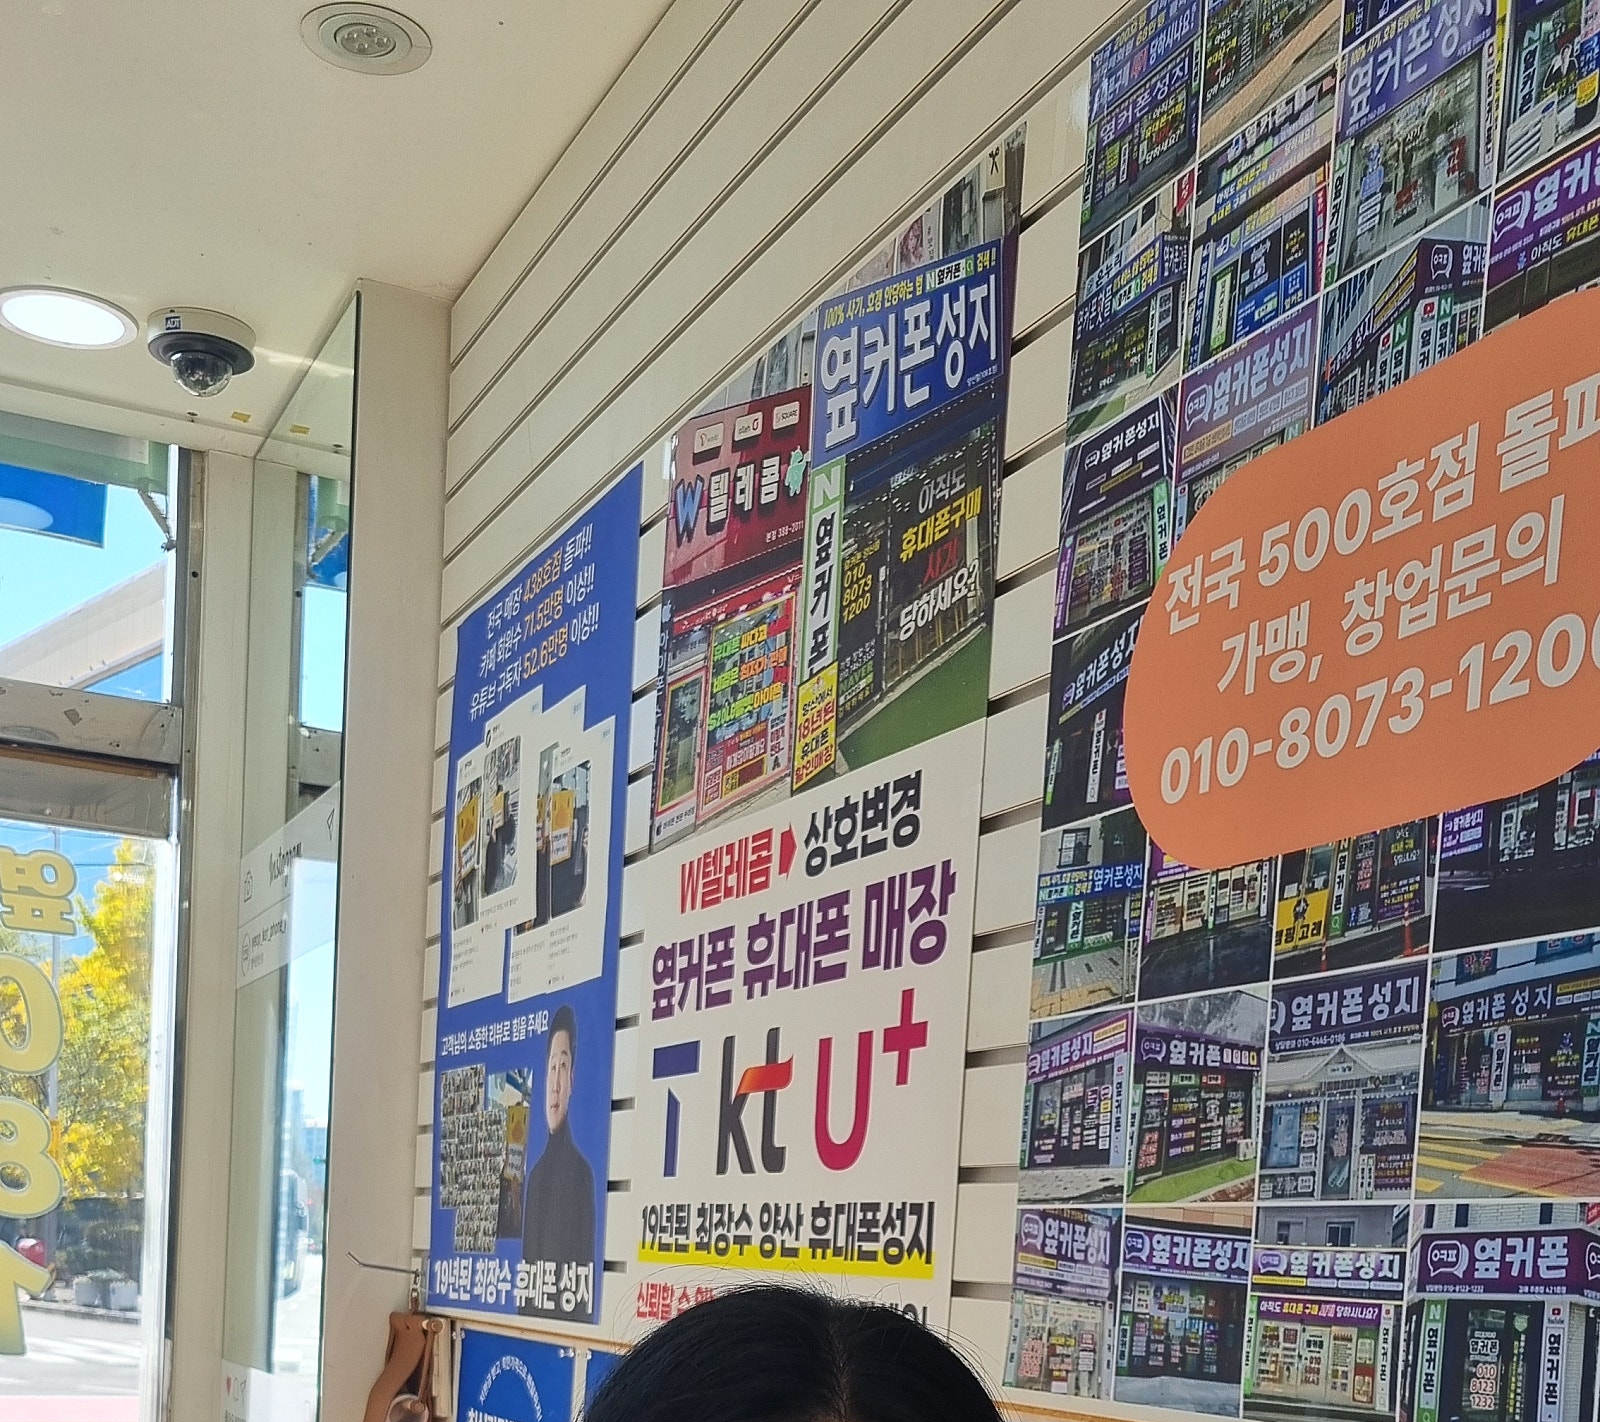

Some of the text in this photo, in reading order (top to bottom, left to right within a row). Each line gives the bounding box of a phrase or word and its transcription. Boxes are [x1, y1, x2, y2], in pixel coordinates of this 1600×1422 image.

[814, 466, 842, 508] N
[919, 463, 967, 513] 아직도
[1164, 538, 1247, 636] 전국
[1257, 420, 1481, 588] 500호점
[523, 548, 564, 605] 438호점
[843, 574, 873, 606] 8073
[845, 562, 866, 588] 010
[900, 558, 980, 642] 당하세요?
[1216, 493, 1566, 697] 가맹, 창업문의
[523, 584, 565, 642] 71.5만명
[842, 593, 871, 624] 1200
[522, 622, 570, 680] 52.6만명
[1160, 610, 1600, 806] 010-8073-120
[679, 768, 923, 916] W텔레콤 상호변경
[651, 858, 958, 1023] 옆커폰 휴대폰 매장
[715, 1026, 794, 1177] kt
[813, 987, 930, 1173] U+
[639, 1199, 936, 1267] 19년된 최장수 양산 휴대폰성지
[1474, 1235, 1570, 1280] 옆커폰
[434, 1255, 595, 1317] 19년된 최장수 휴대폰 성지
[1430, 1304, 1441, 1320] N
